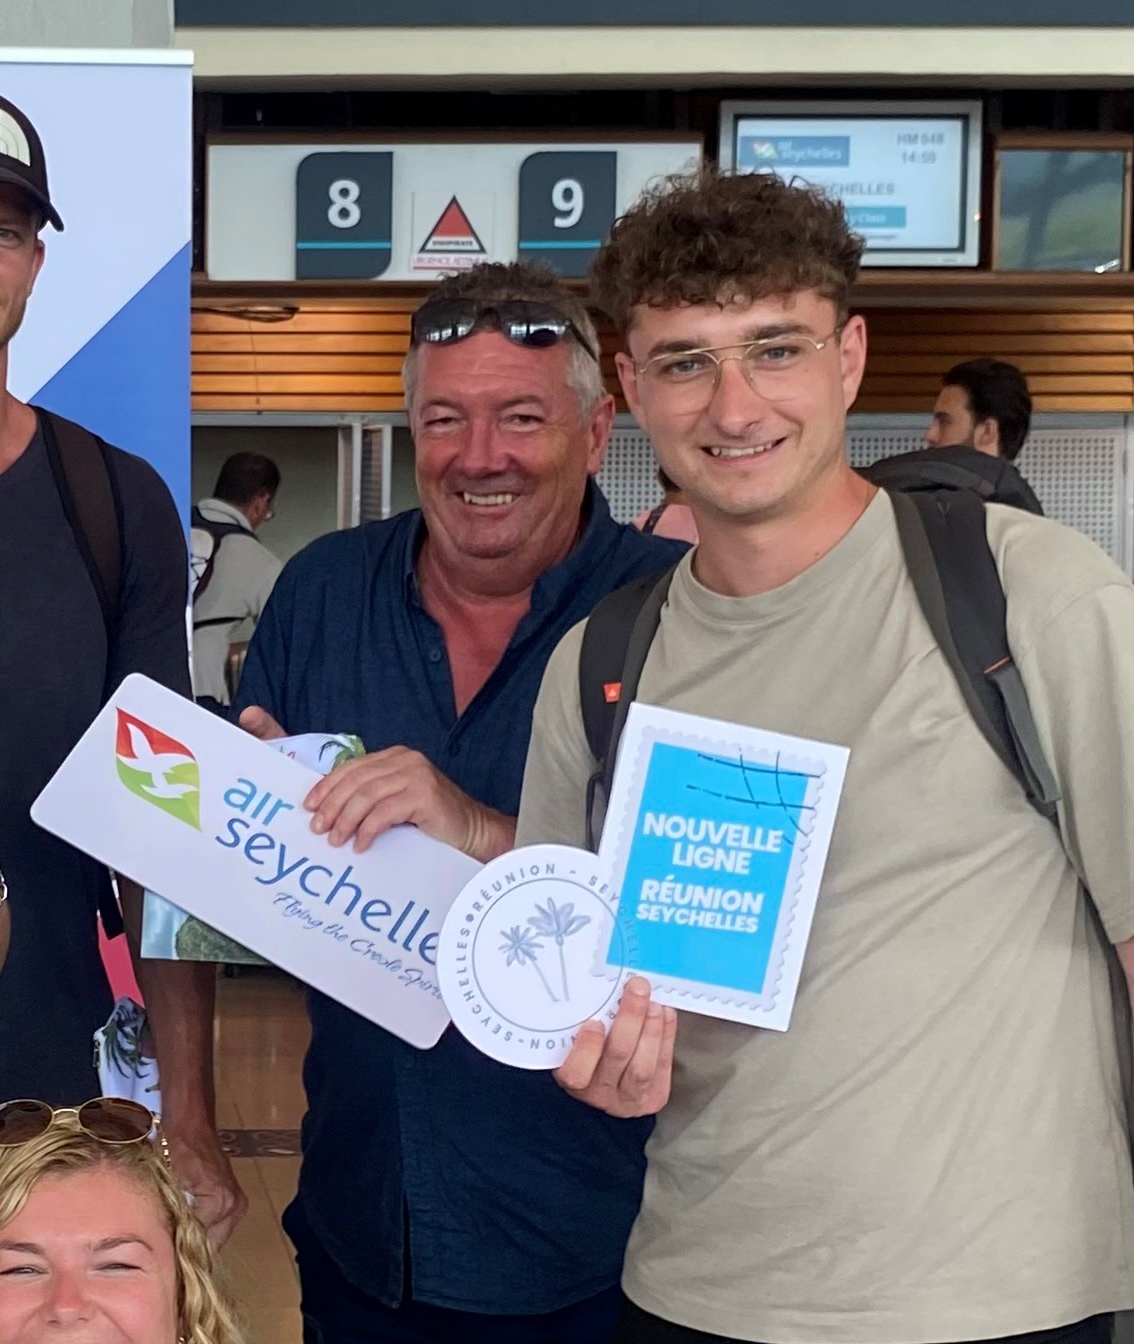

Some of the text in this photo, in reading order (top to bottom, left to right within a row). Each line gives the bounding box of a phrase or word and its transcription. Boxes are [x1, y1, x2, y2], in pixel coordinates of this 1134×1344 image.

[327, 178, 362, 229] 8
[551, 178, 585, 229] 9
[223, 777, 295, 827] air
[642, 812, 784, 854] NOUVELLE
[672, 842, 753, 875] LIGNE
[215, 817, 439, 966] seychelle
[639, 874, 765, 915] RÉUNION
[472, 863, 555, 912] RÉUNION
[588, 875, 639, 990] SEYCHELLE
[635, 903, 759, 935] SEYCHELLES
